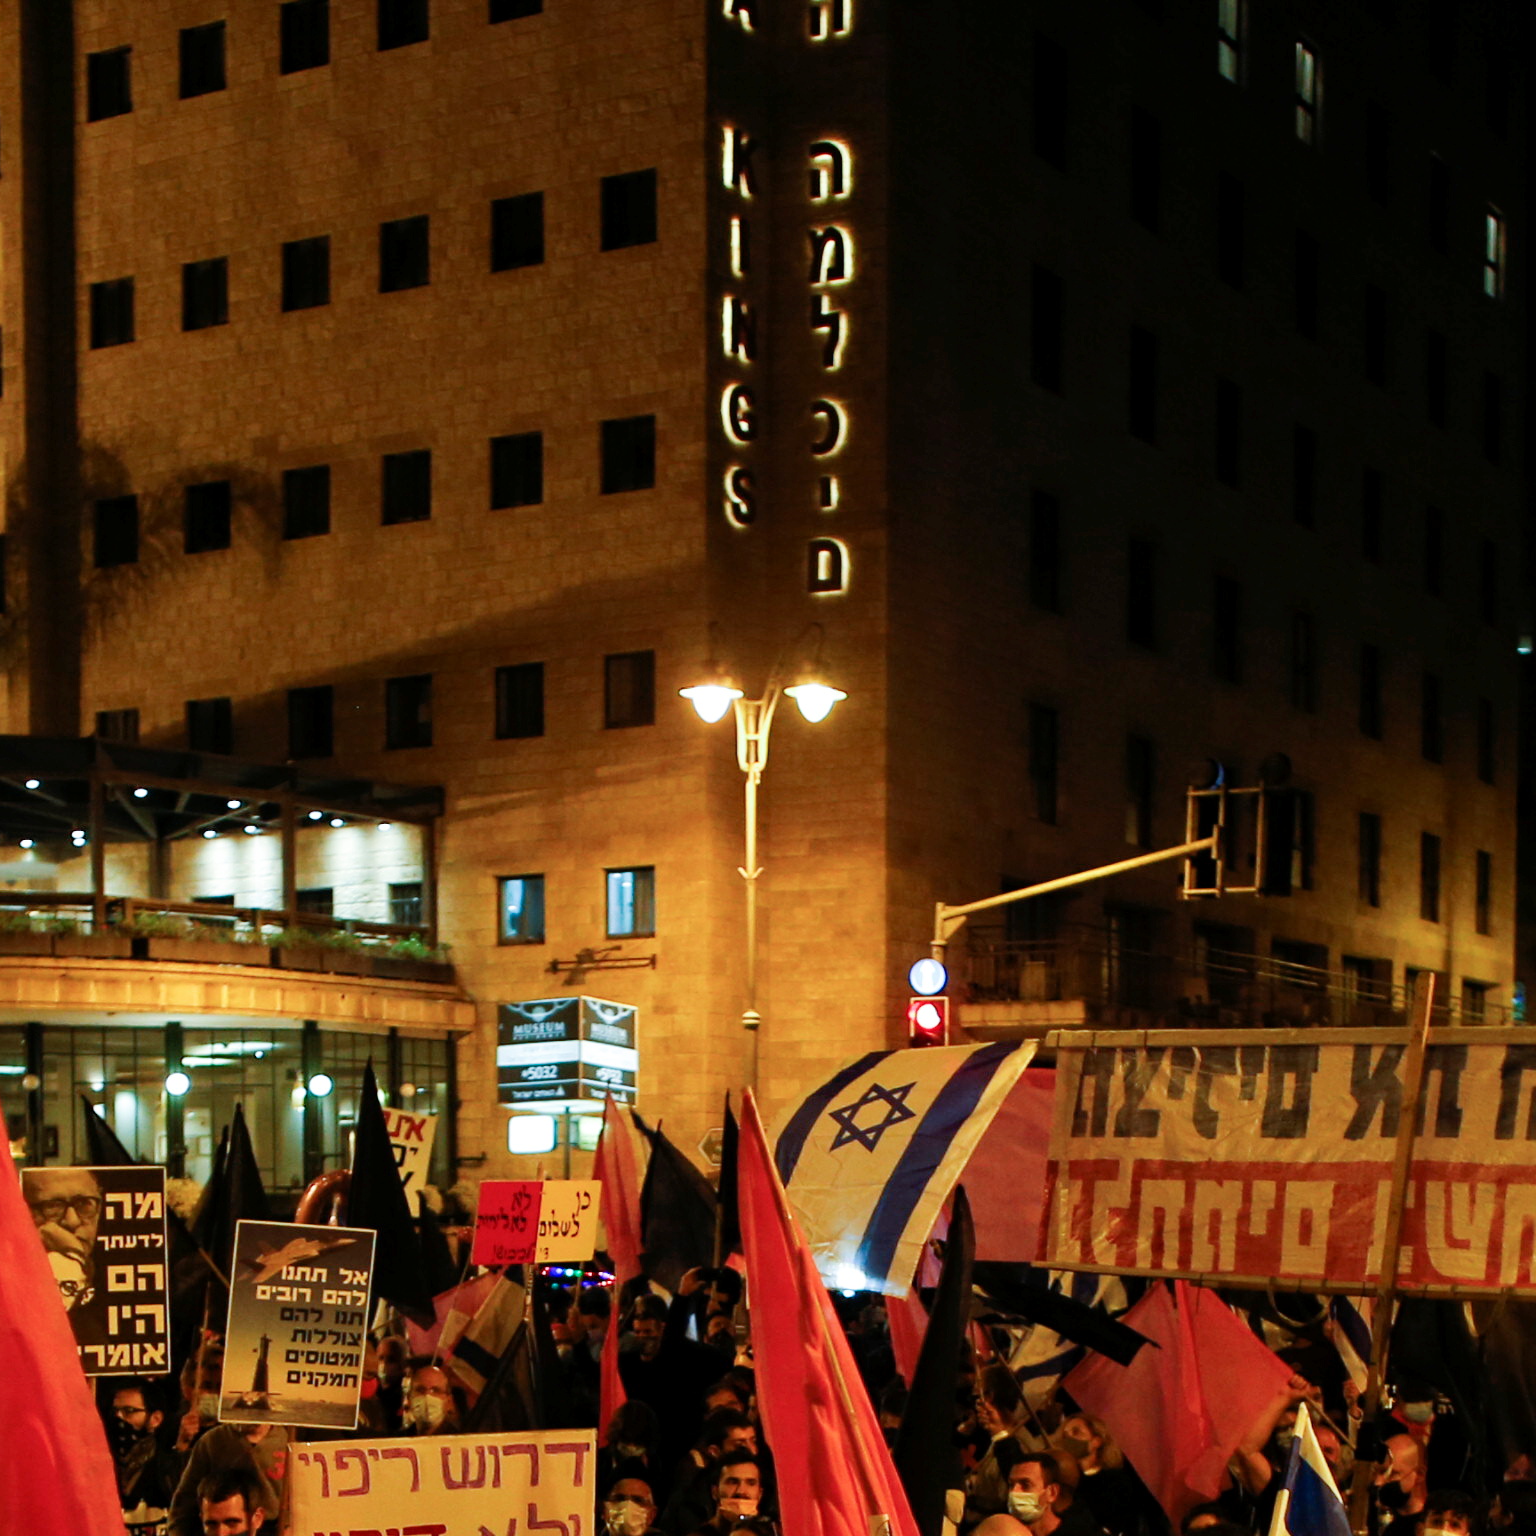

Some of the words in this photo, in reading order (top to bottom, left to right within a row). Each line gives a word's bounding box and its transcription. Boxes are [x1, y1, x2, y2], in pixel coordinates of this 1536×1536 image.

[720, 125, 757, 530] KINGS
[807, 138, 855, 598] המלכים
[104, 1191, 163, 1220] מה
[576, 1190, 592, 1217] כן
[538, 1209, 581, 1239] לשלום
[96, 1231, 164, 1252] לדעתך
[106, 1264, 164, 1292] הם
[280, 1264, 328, 1284] תתנו
[340, 1267, 368, 1286] אל
[255, 1283, 313, 1303] רובים
[321, 1285, 367, 1307] להם
[107, 1304, 165, 1336] היו
[279, 1303, 325, 1324] להם
[333, 1309, 363, 1327] תנו
[291, 1326, 362, 1348] צוללות
[76, 1343, 166, 1367] אומרי
[284, 1348, 360, 1367] ומטוסים
[286, 1368, 358, 1389] חמקנים
[296, 1446, 421, 1499] ריפוי
[440, 1442, 591, 1492] דרוש
